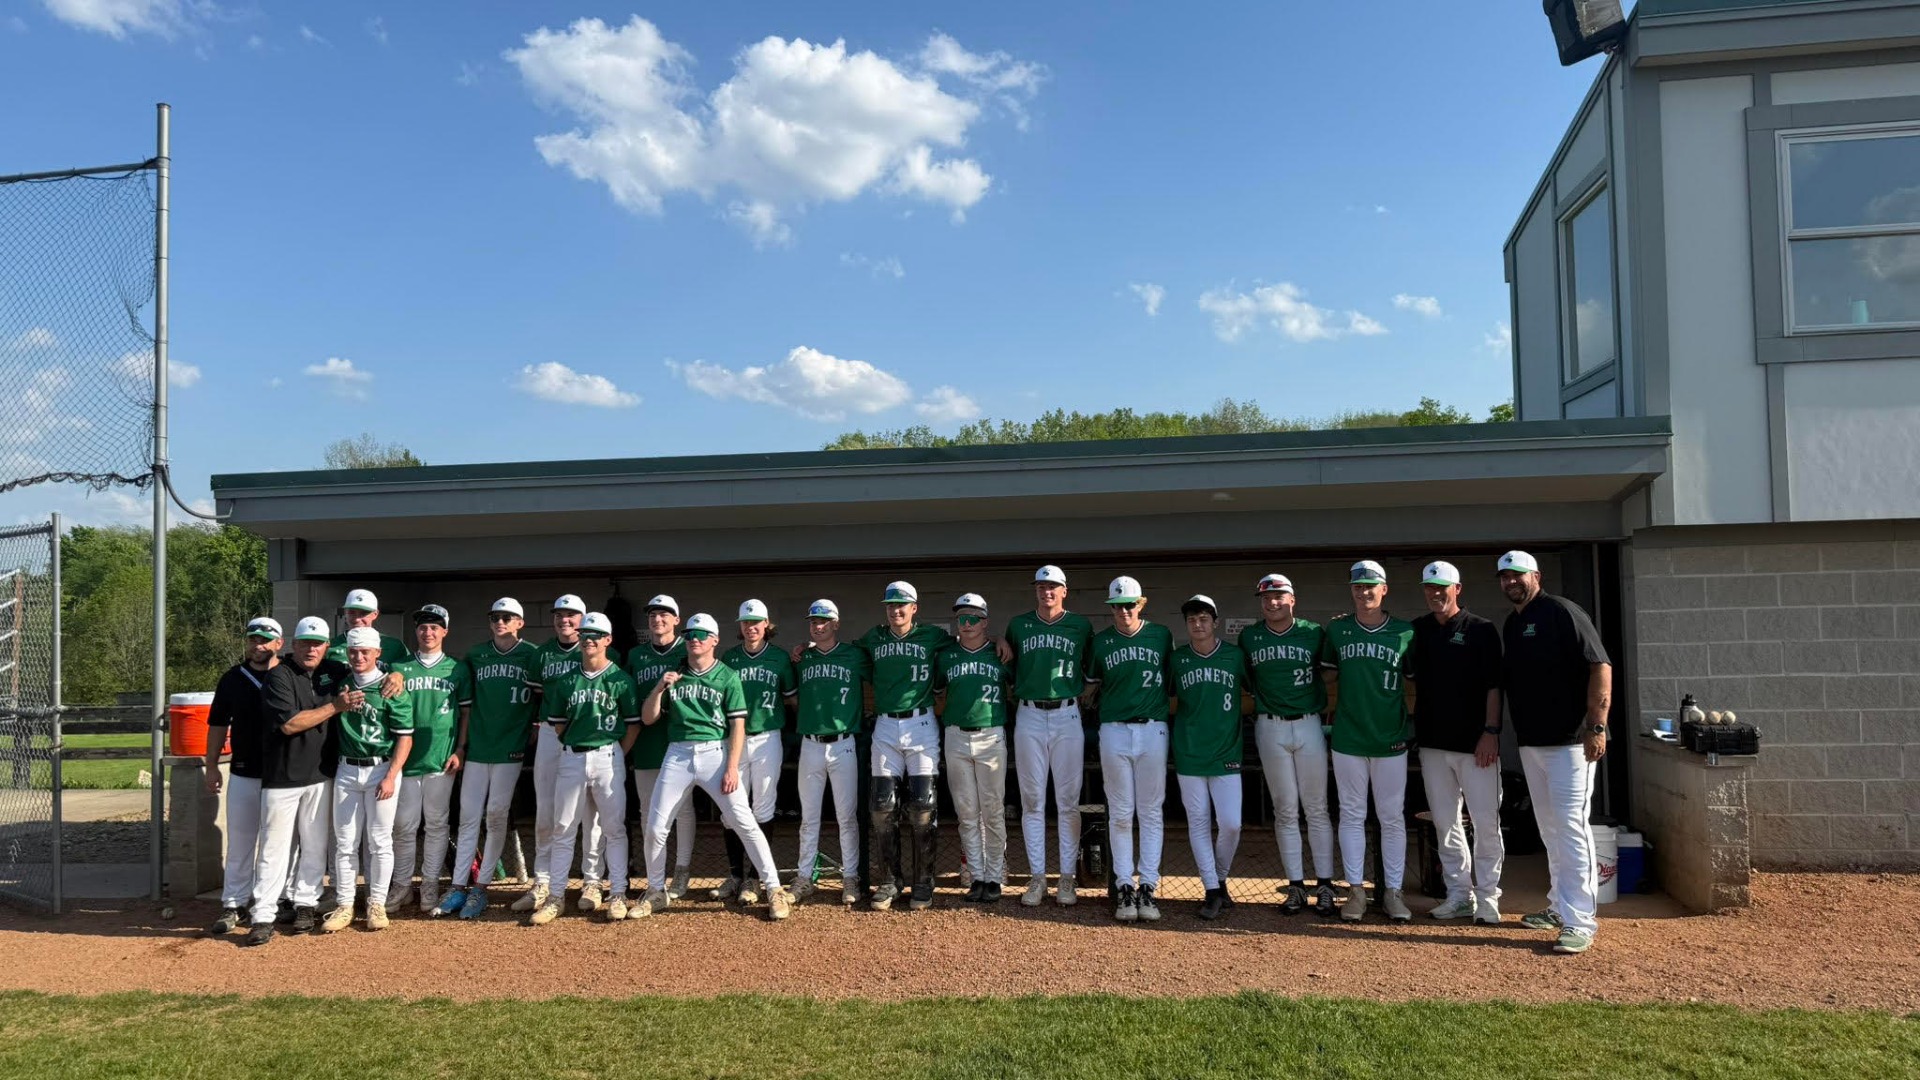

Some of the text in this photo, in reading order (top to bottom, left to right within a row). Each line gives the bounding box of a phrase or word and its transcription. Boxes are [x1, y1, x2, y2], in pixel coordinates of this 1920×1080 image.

[874, 642, 926, 661] HORNETS
[1022, 634, 1075, 655] HORNETS
[1340, 642, 1400, 667] HORNETS
[1105, 646, 1160, 670] HORNETS
[1251, 645, 1311, 666] HORNETS
[477, 663, 528, 682] HORNETS
[637, 664, 672, 685] HORN
[802, 663, 851, 684] HORNETS
[911, 664, 930, 682] 15
[947, 661, 1000, 682] HORNETS
[1141, 669, 1163, 688] 24
[1181, 667, 1235, 690] HORNETS
[1293, 665, 1313, 686] 25
[1383, 670, 1398, 690] 11
[510, 686, 531, 704] 10
[669, 684, 723, 706] HORNETS
[761, 690, 777, 709] 21
[839, 687, 850, 705] 7
[981, 684, 1000, 703] 22
[1223, 692, 1232, 712] 8
[596, 712, 617, 732] 19
[360, 723, 382, 743] 12
